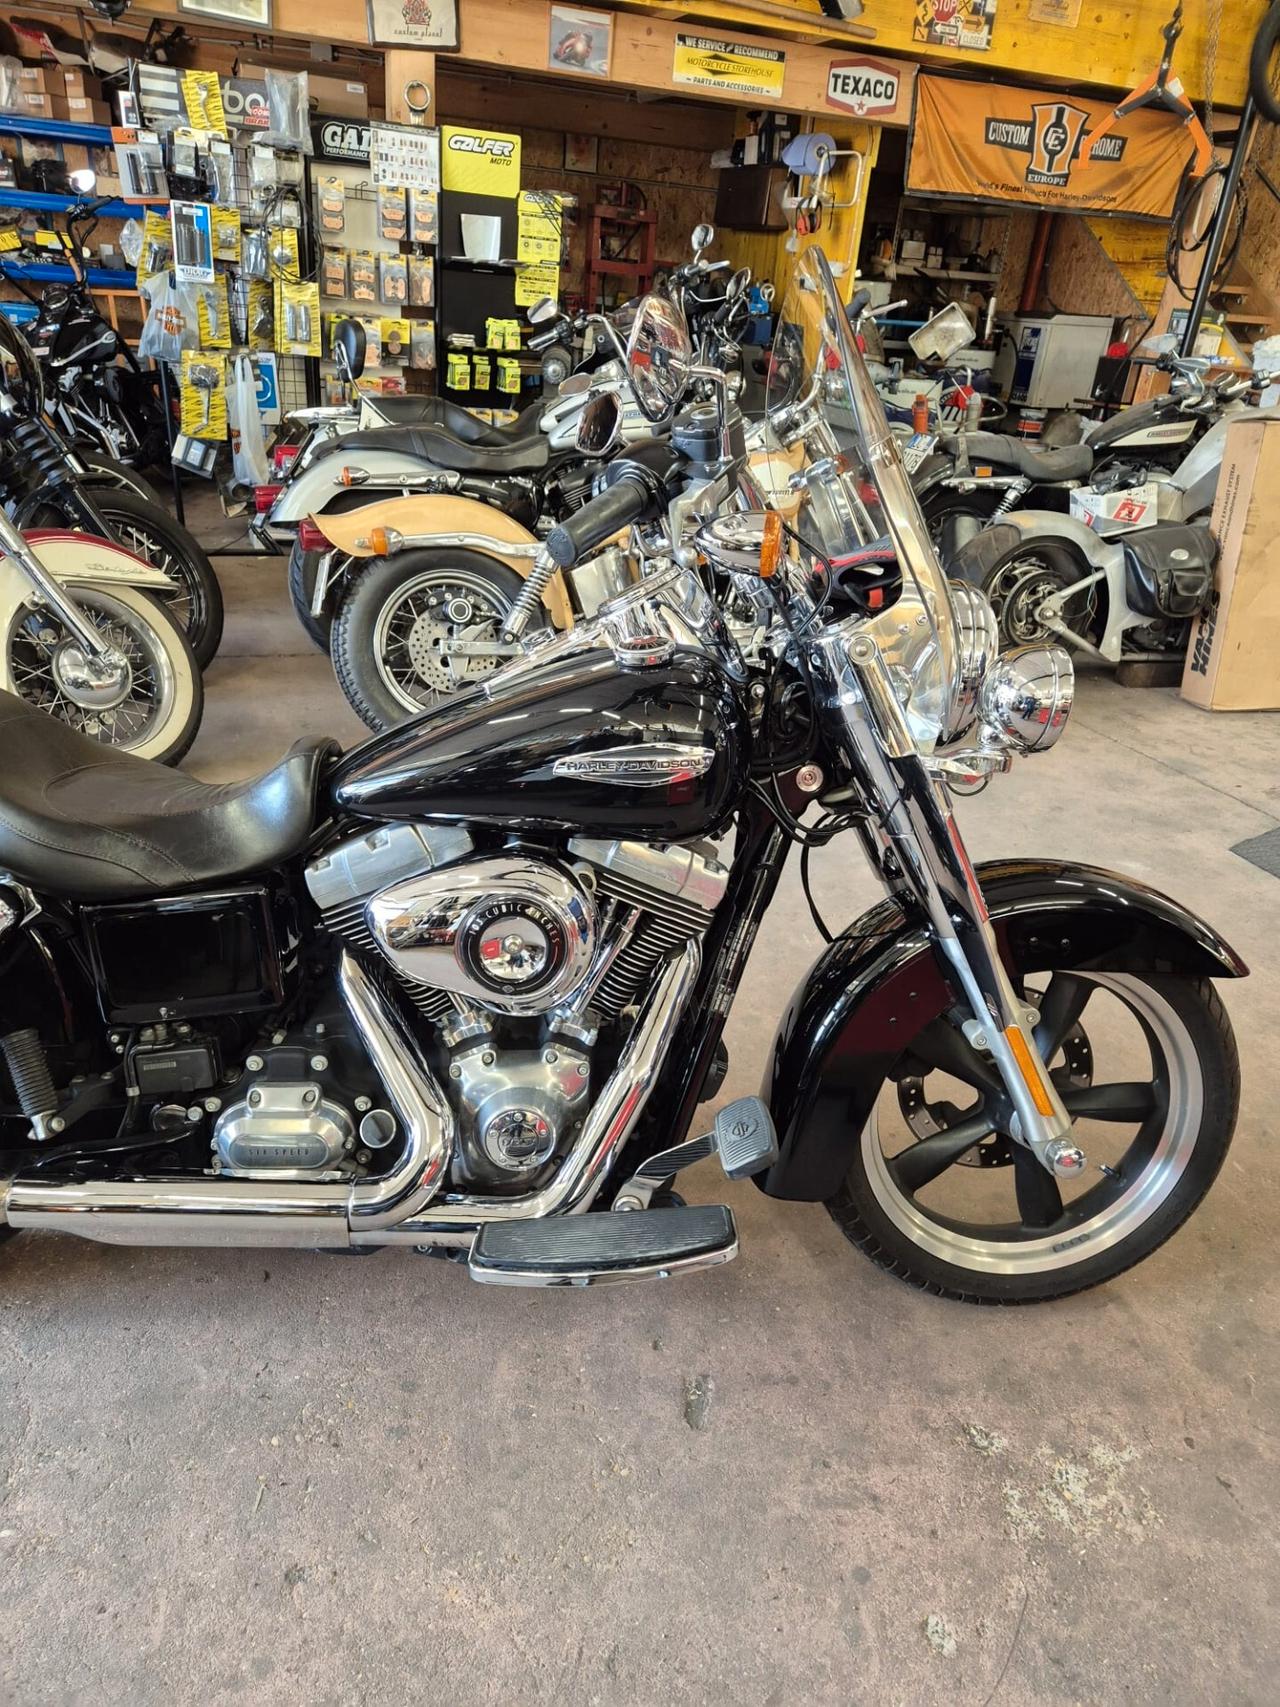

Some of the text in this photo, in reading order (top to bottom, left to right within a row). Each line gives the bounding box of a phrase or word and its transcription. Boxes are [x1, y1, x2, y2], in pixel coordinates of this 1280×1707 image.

[932, 0, 957, 11] STOP
[685, 36, 697, 48] WE
[697, 39, 726, 53] SERVICE
[734, 45, 779, 61] RECOMMEND
[687, 57, 774, 78] MOTORCYCLE STOREHOUSE
[693, 77, 764, 94] PARTS AND ACCESSORIES
[831, 72, 895, 100] TEXACO
[988, 121, 1031, 146] CUSTOM
[326, 149, 368, 159] PERFORMANCE
[450, 134, 514, 158] GALFER
[489, 157, 512, 166] MOTO
[1027, 173, 1067, 186] EUROPE
[565, 758, 701, 772] HARLEY-DAVIDSON
[485, 904, 522, 919] CUBIC
[525, 906, 560, 944] INCHES
